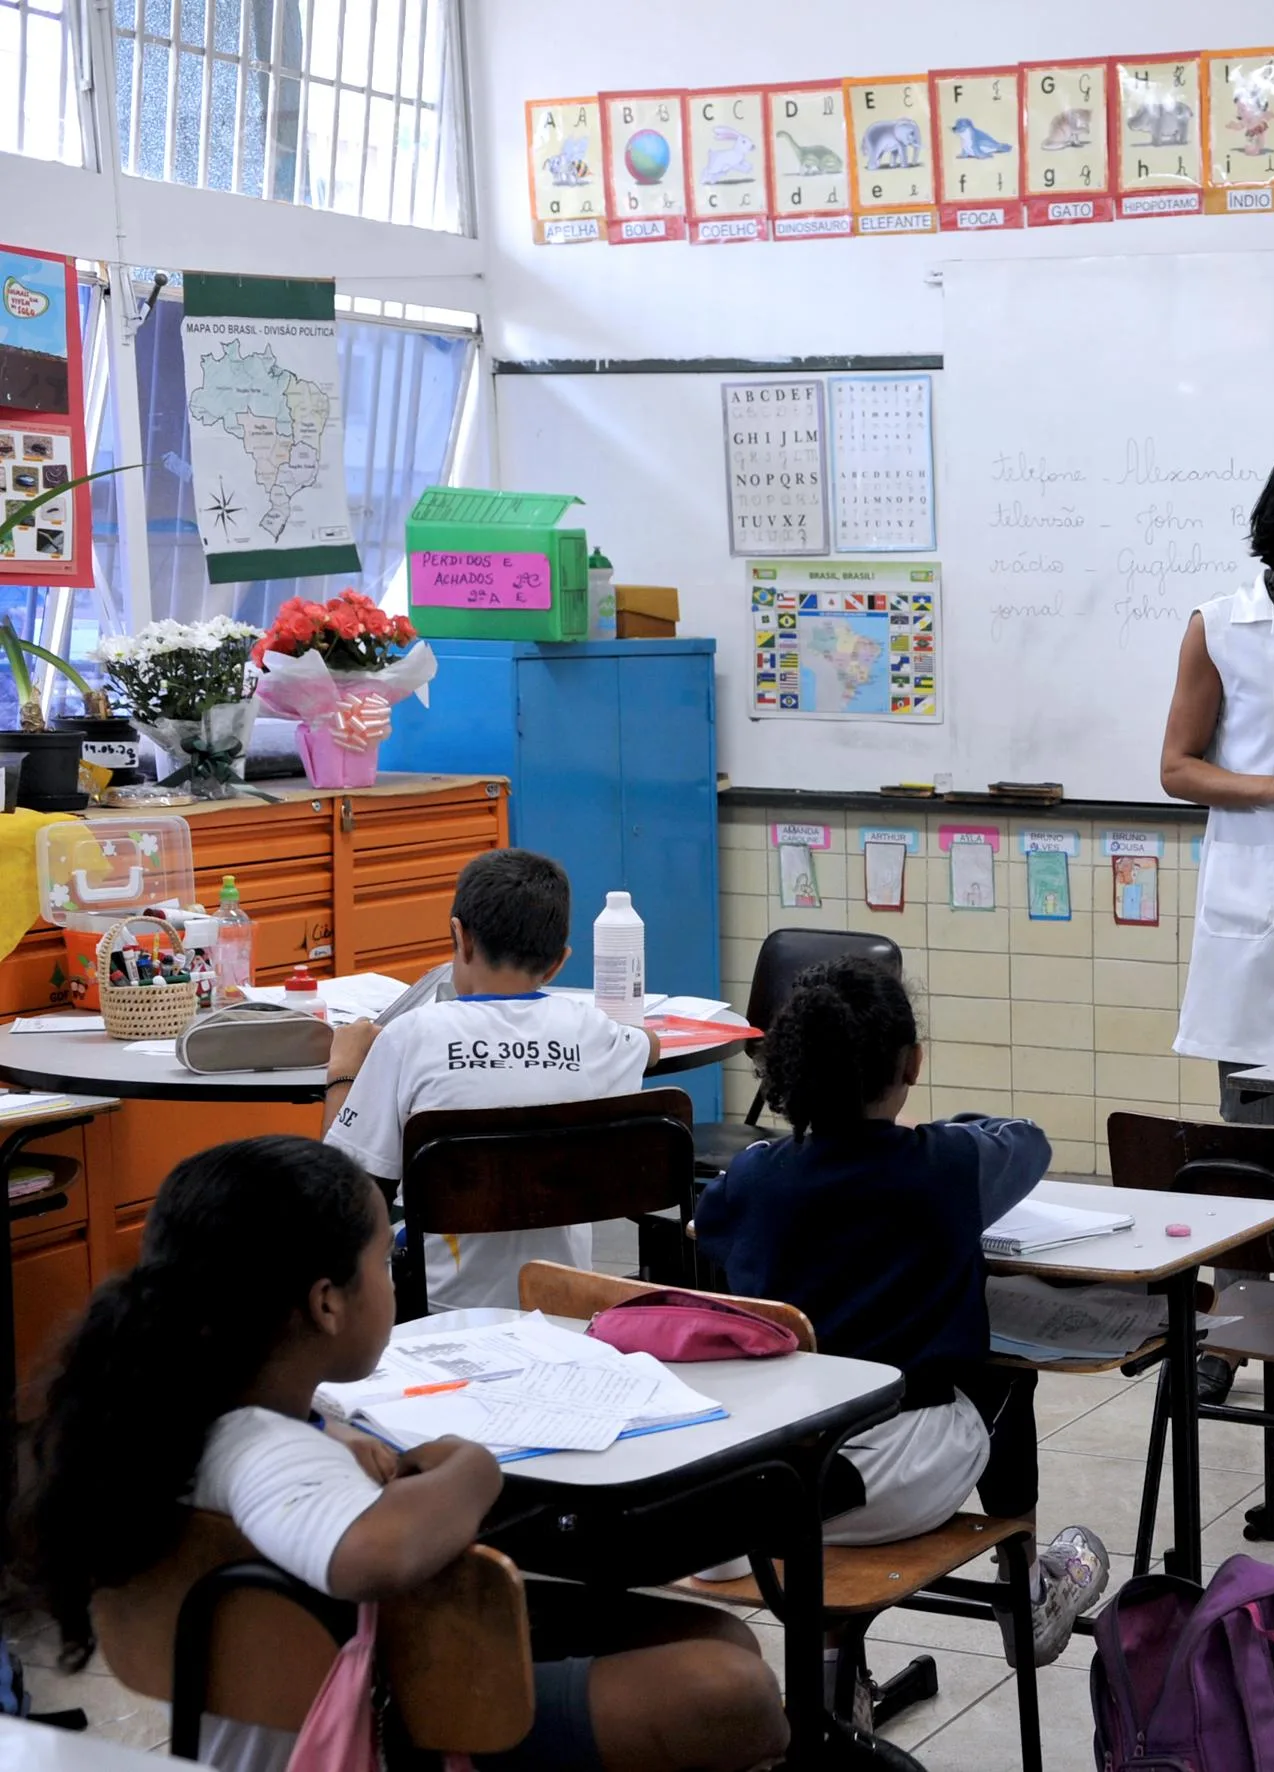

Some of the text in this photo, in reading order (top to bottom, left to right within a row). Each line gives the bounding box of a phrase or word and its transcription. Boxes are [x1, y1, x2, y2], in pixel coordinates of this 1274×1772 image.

[1041, 76, 1055, 95] G
[865, 91, 876, 110] E
[953, 85, 963, 103] F
[622, 106, 634, 125] B
[702, 103, 715, 121] C
[786, 100, 798, 118] D
[1229, 190, 1271, 208] ÍNDIO
[959, 211, 999, 226] FOCA
[1051, 203, 1092, 218] GATO
[625, 222, 660, 237] BOLA
[777, 219, 848, 234] DINOSSAURO
[861, 214, 931, 231] ELEFANTE
[186, 323, 334, 337] MAPA DO BRASIL DIVISÃO POLÍTICA
[1118, 436, 1260, 485] Alexander
[1136, 500, 1204, 545] John
[422, 551, 513, 568] PERDIDOS E
[434, 572, 494, 586] ACHADOS
[516, 592, 527, 603] E
[870, 832, 906, 842] ARTHUR
[959, 833, 982, 843] AYLA
[1030, 832, 1064, 842] BRUNO
[1112, 832, 1147, 842] BRUNO
[448, 1040, 581, 1063] E.C 305 Sul
[448, 1060, 580, 1072] DRE. PP/C
